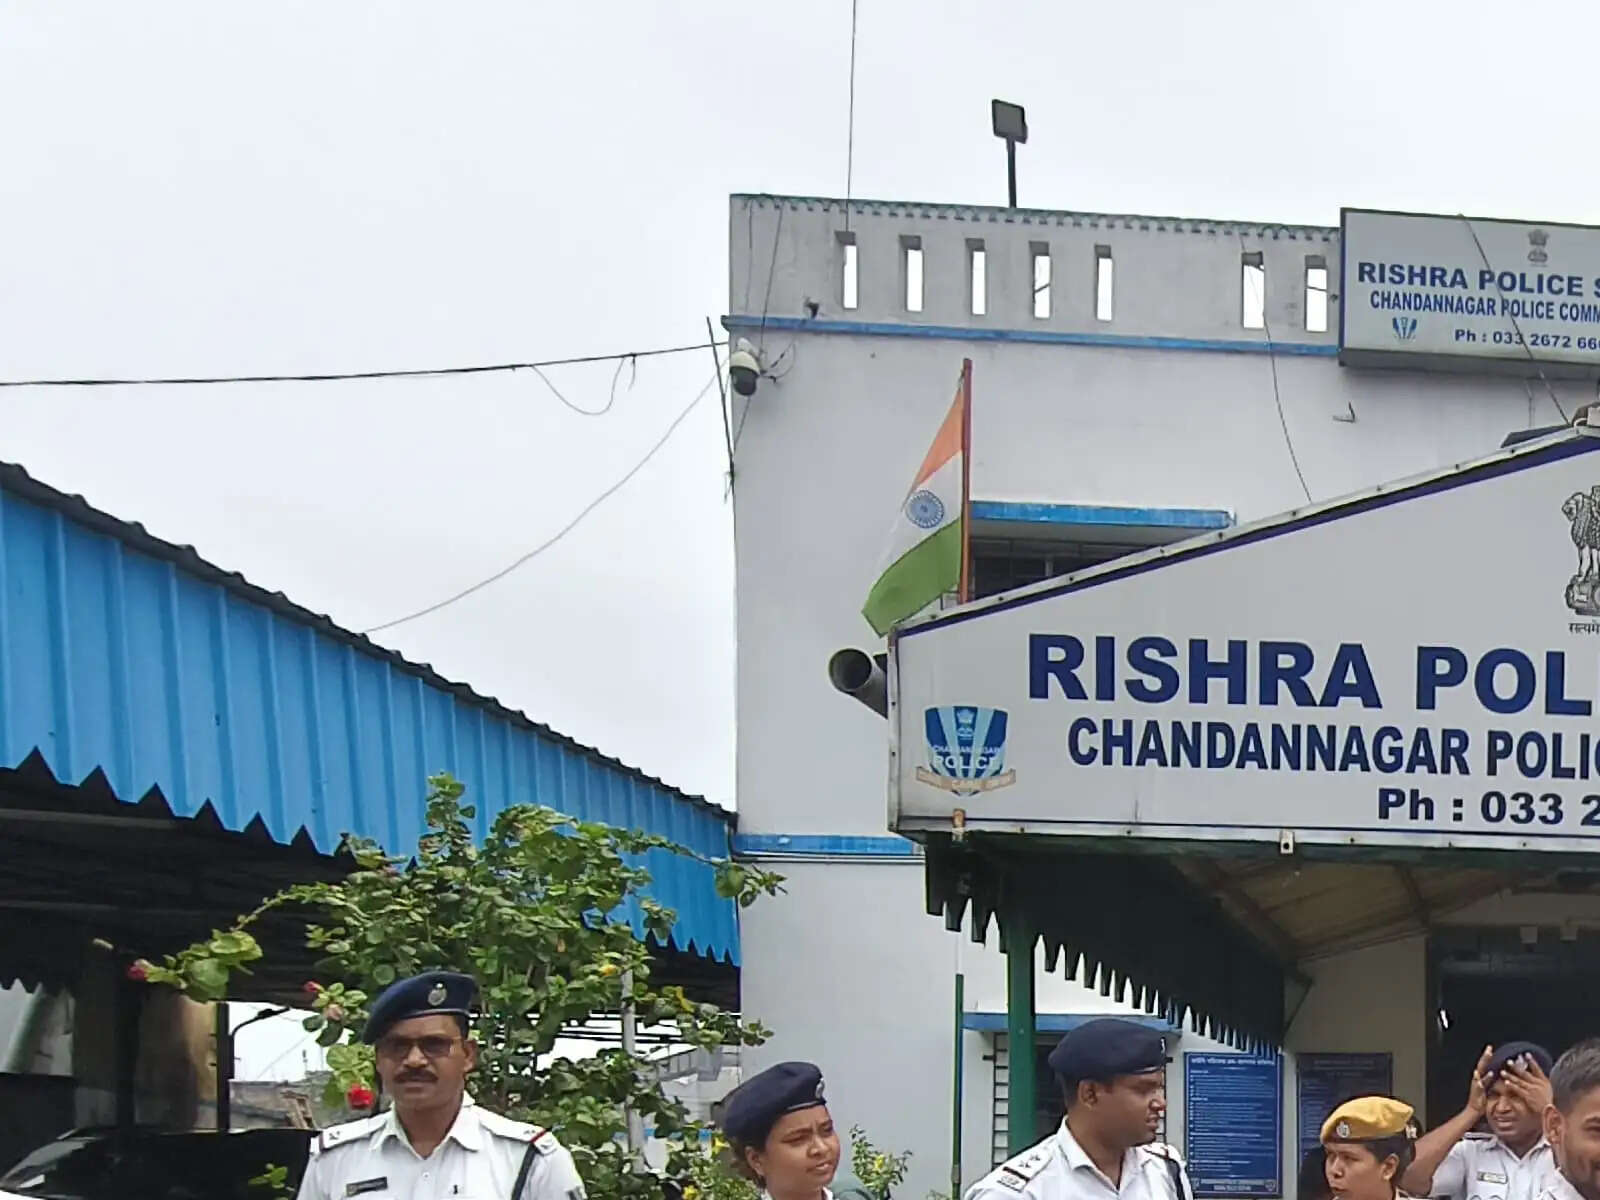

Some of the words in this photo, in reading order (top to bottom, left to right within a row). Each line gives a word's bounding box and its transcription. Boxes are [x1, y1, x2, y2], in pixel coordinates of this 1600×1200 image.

[1358, 262, 1468, 290] RISHRA
[1479, 271, 1583, 298] POLICE
[1370, 290, 1496, 317] CHANDANNAGAR
[1501, 299, 1554, 321] POLICE
[1455, 329, 1476, 343] Ph
[1493, 330, 1524, 346] 033
[1530, 333, 1571, 349] 2672
[1028, 633, 1382, 710] RISHRA
[1068, 718, 1469, 777] CHANDANNAGAR
[1378, 788, 1434, 822] Ph
[1480, 792, 1564, 826] 033
